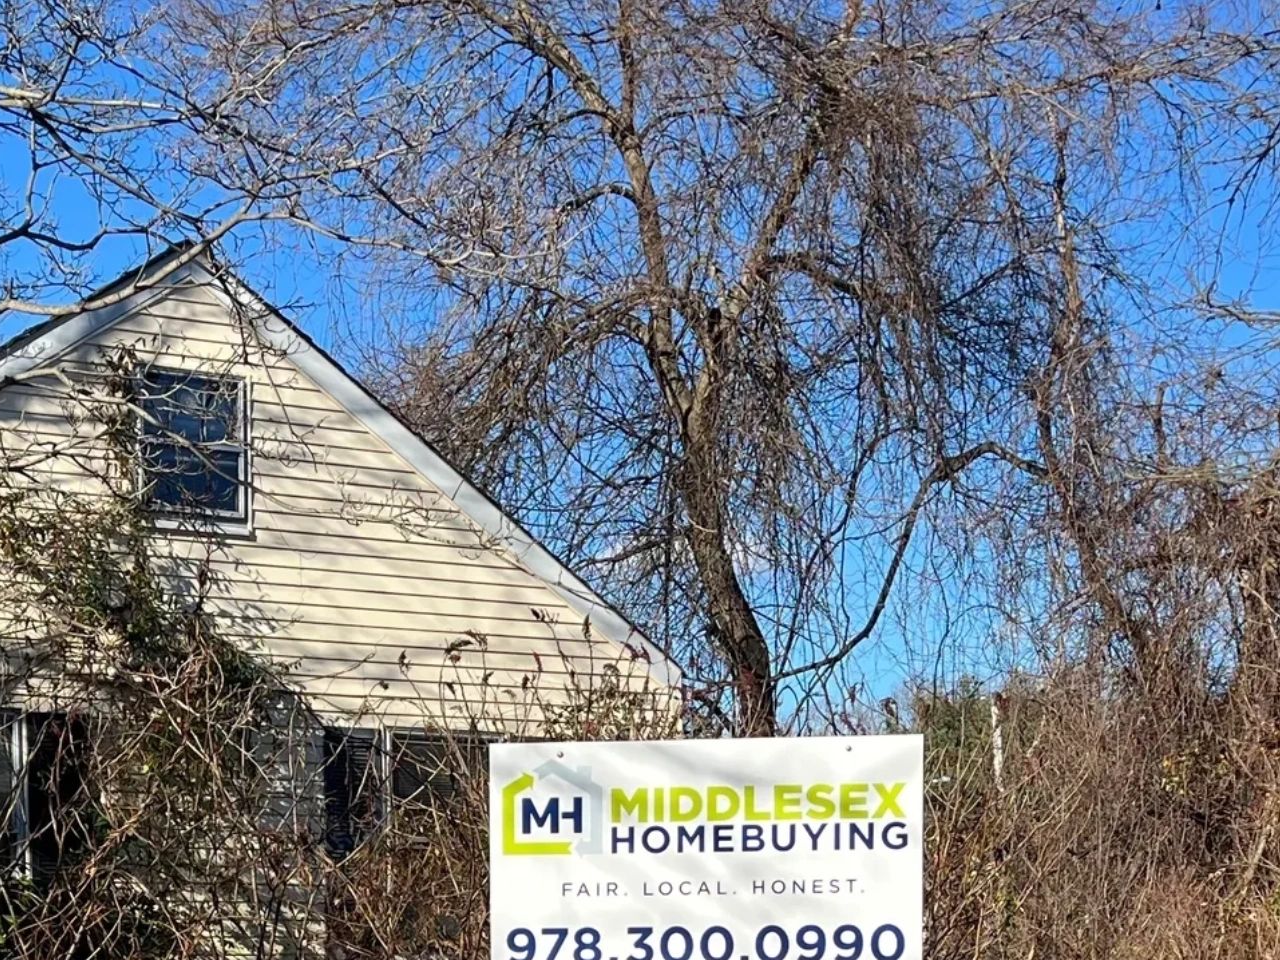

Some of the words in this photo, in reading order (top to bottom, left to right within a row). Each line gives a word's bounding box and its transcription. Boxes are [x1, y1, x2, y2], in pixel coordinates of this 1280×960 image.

[521, 797, 583, 835] MH
[610, 782, 907, 823] MIDDLESEX
[611, 822, 909, 854] HOMEBUYING
[561, 881, 629, 897] FAIR.
[643, 880, 738, 896] LOCAL.
[752, 878, 866, 895] HONEST.
